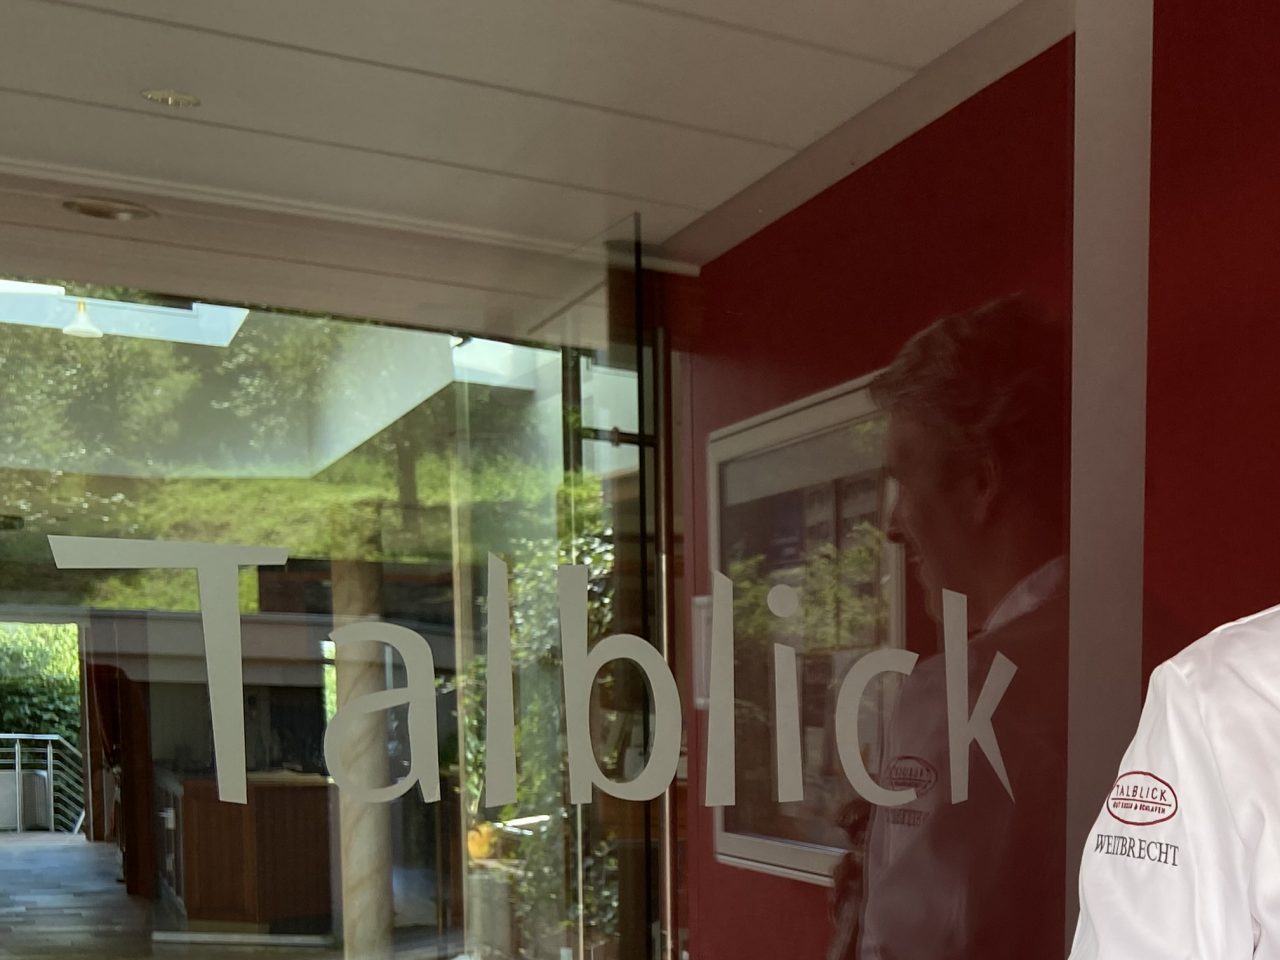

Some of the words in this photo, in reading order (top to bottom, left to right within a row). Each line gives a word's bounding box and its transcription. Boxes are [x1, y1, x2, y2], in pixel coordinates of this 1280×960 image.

[47, 534, 1018, 807] Talblick
[1116, 784, 1167, 802] TALBLICK
[1094, 833, 1180, 867] WEITBRECHT
